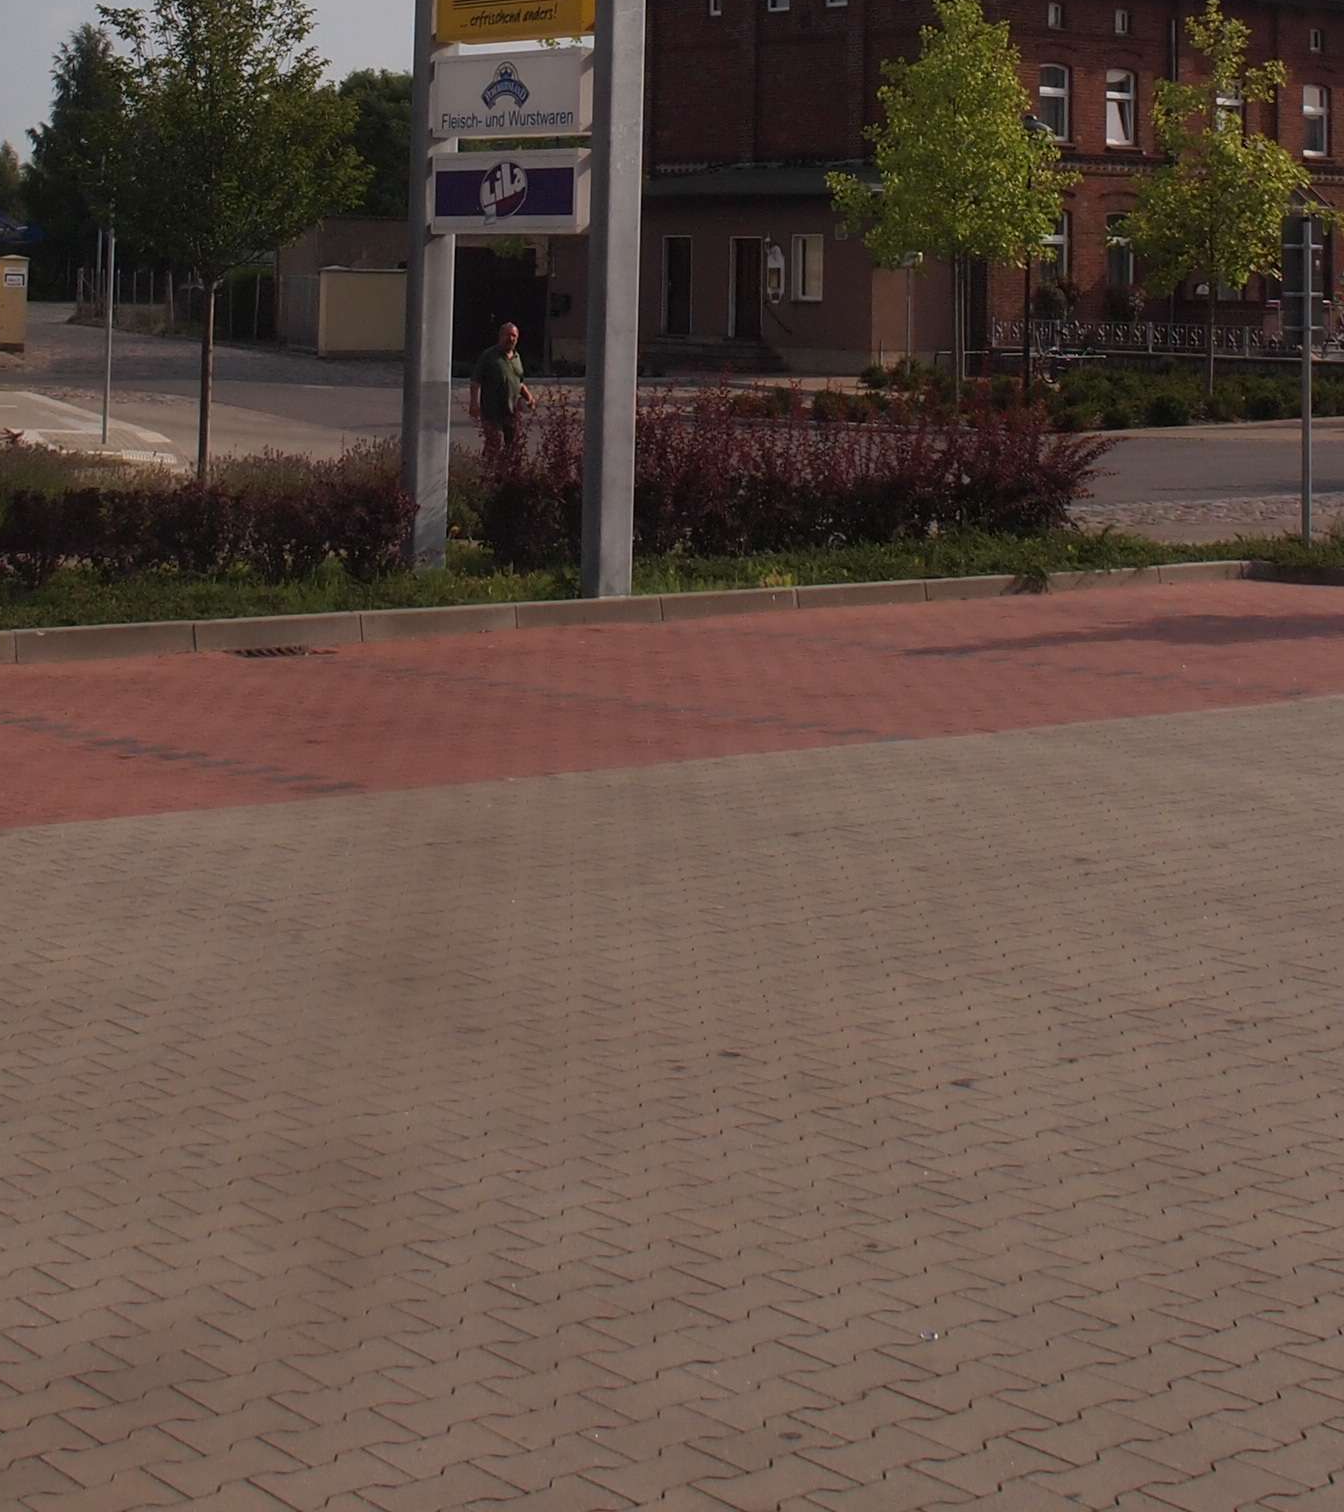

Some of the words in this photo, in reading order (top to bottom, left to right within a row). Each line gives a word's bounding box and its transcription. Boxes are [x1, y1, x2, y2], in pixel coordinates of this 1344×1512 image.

[441, 113, 483, 129] Fleisch-
[485, 111, 505, 128] und
[508, 110, 574, 127] Wurstwaren
